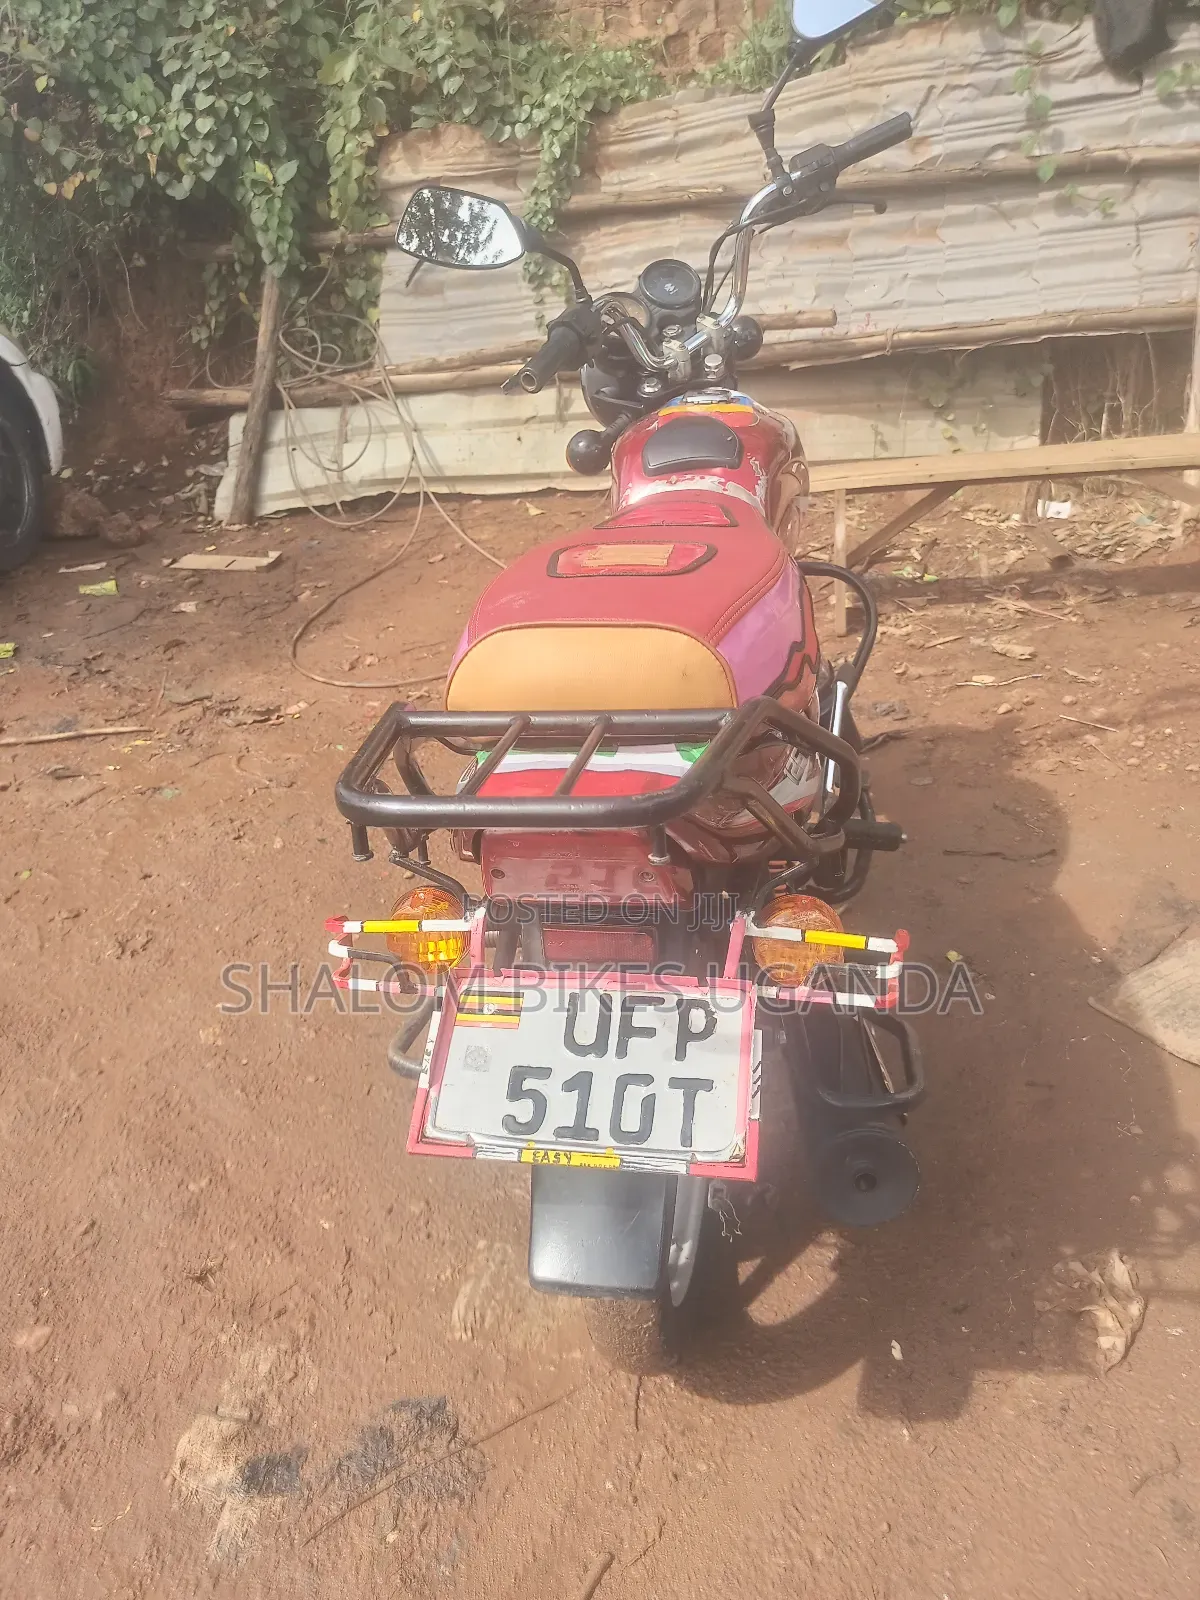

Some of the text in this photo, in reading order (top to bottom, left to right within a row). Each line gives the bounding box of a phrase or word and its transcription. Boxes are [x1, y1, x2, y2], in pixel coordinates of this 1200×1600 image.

[563, 991, 718, 1061] UFP
[501, 1065, 714, 1148] 510T
[532, 1150, 572, 1167] EASY
